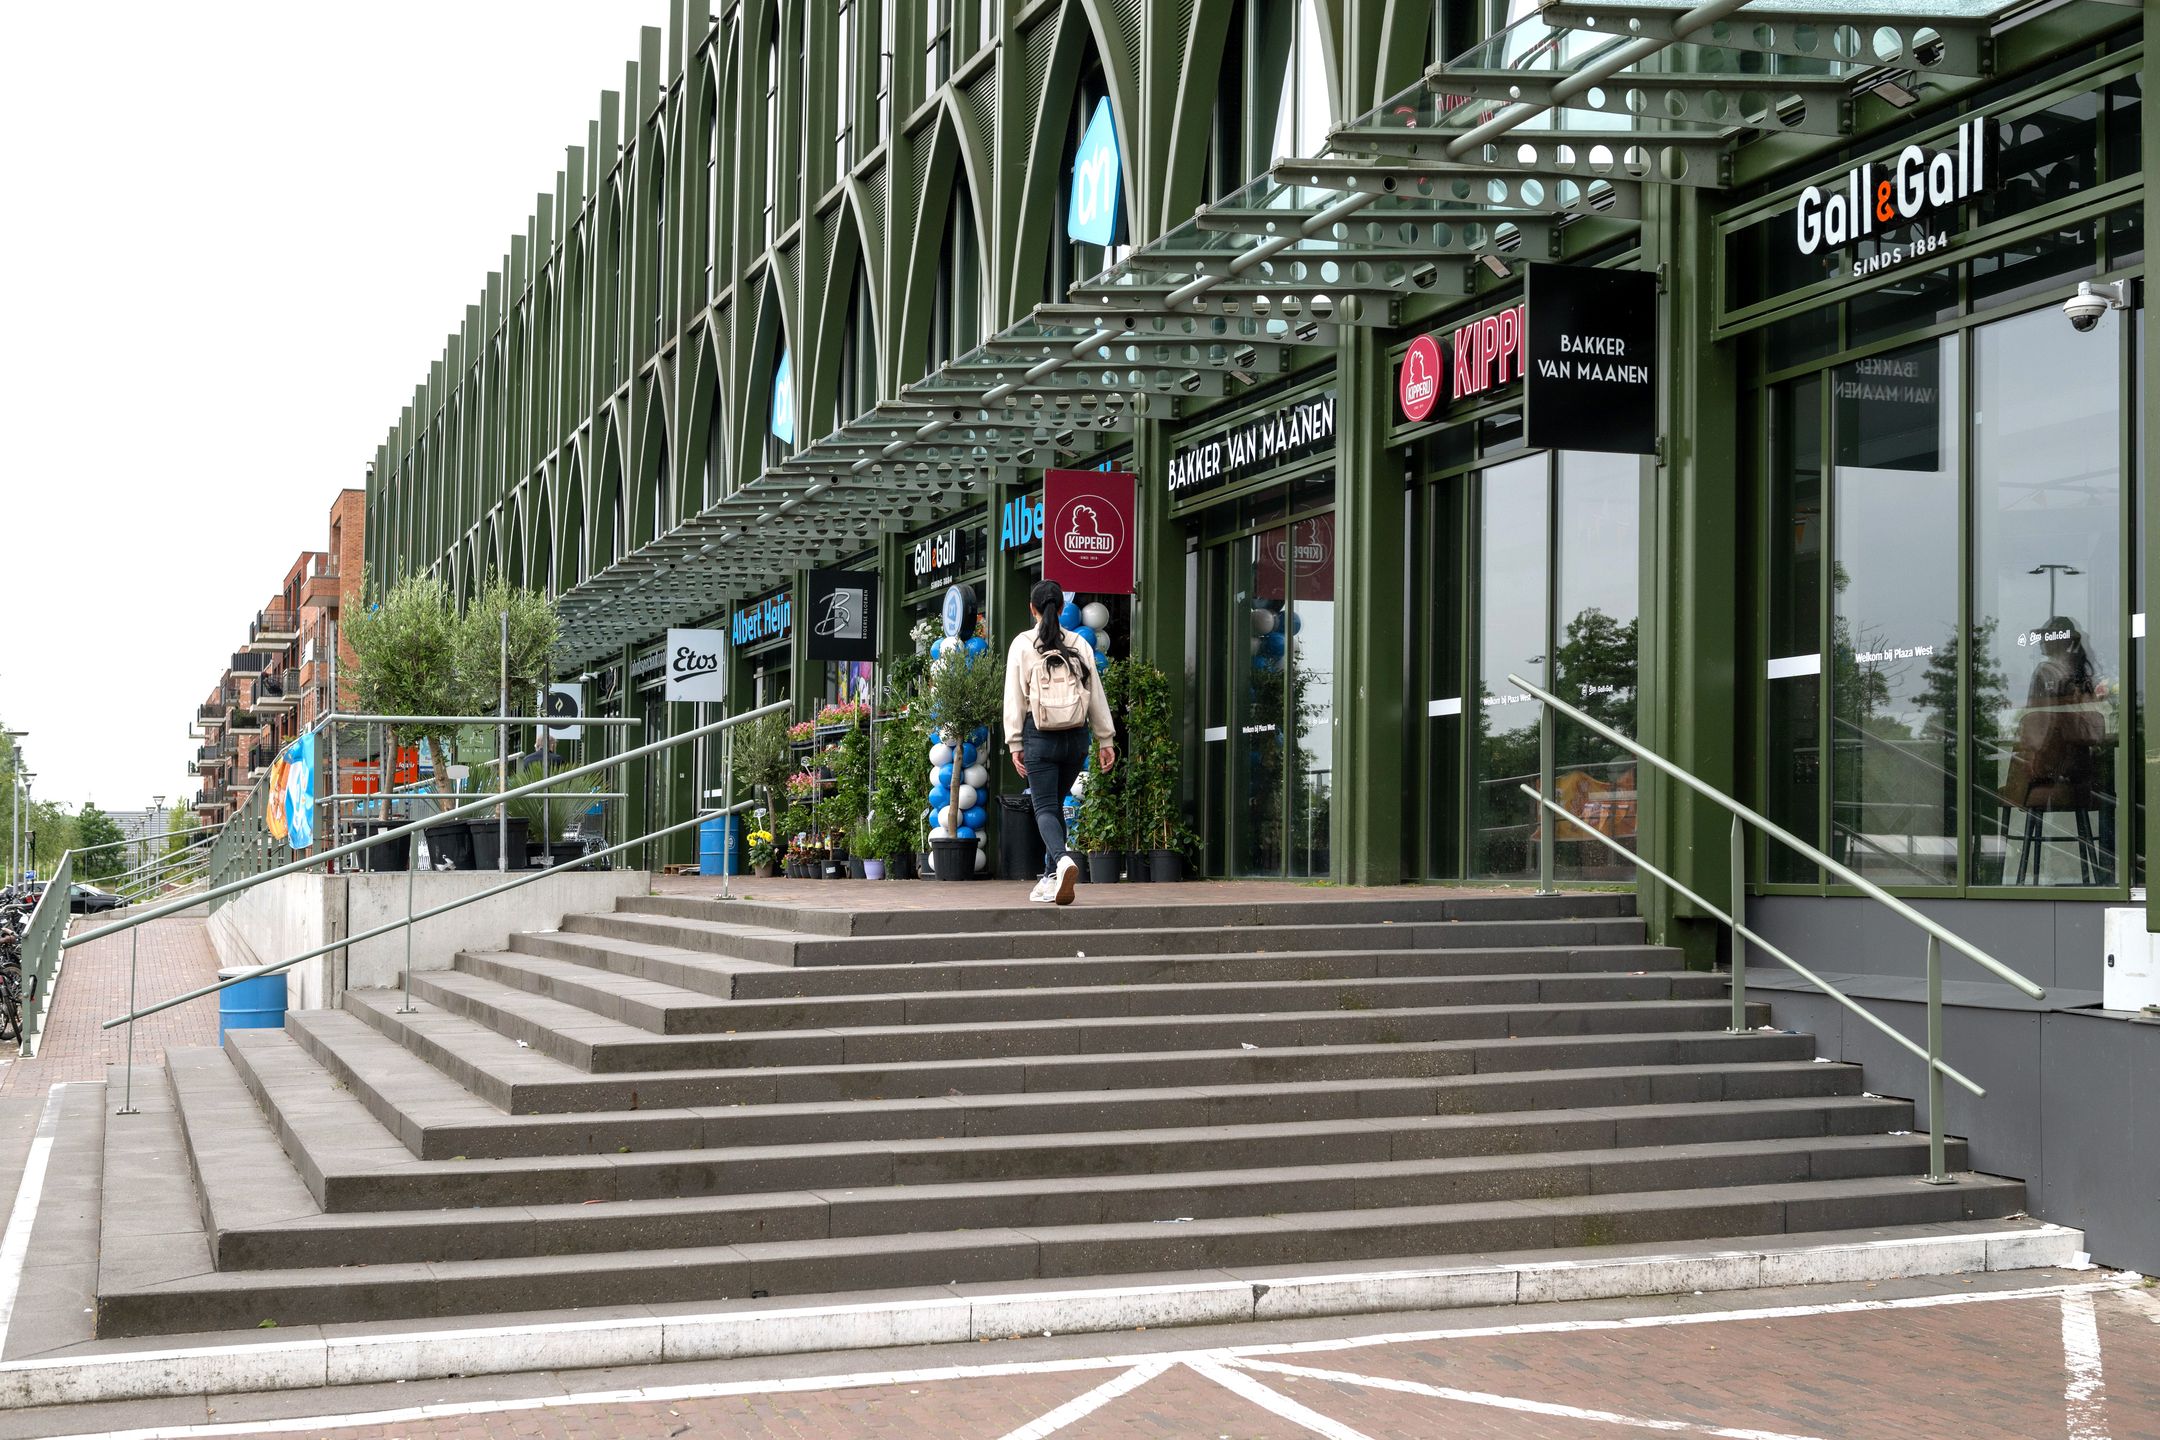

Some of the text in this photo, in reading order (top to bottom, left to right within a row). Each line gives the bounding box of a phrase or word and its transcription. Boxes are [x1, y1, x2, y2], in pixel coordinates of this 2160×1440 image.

[1853, 231, 1948, 277] SINDS 1884
[1560, 334, 1625, 356] BAKKER
[1538, 359, 1649, 384] VAN MAANEN
[1407, 379, 1431, 401] KIPPERIJ
[1168, 398, 1334, 491] BAKKER VAN MAANEN
[1000, 495, 1043, 551] Albe
[1068, 535, 1110, 550] KIPPERIJ
[732, 593, 791, 646] Albert Heijn
[672, 646, 718, 683] Etos
[1855, 645, 1933, 663] Welkom bij Plaza West
